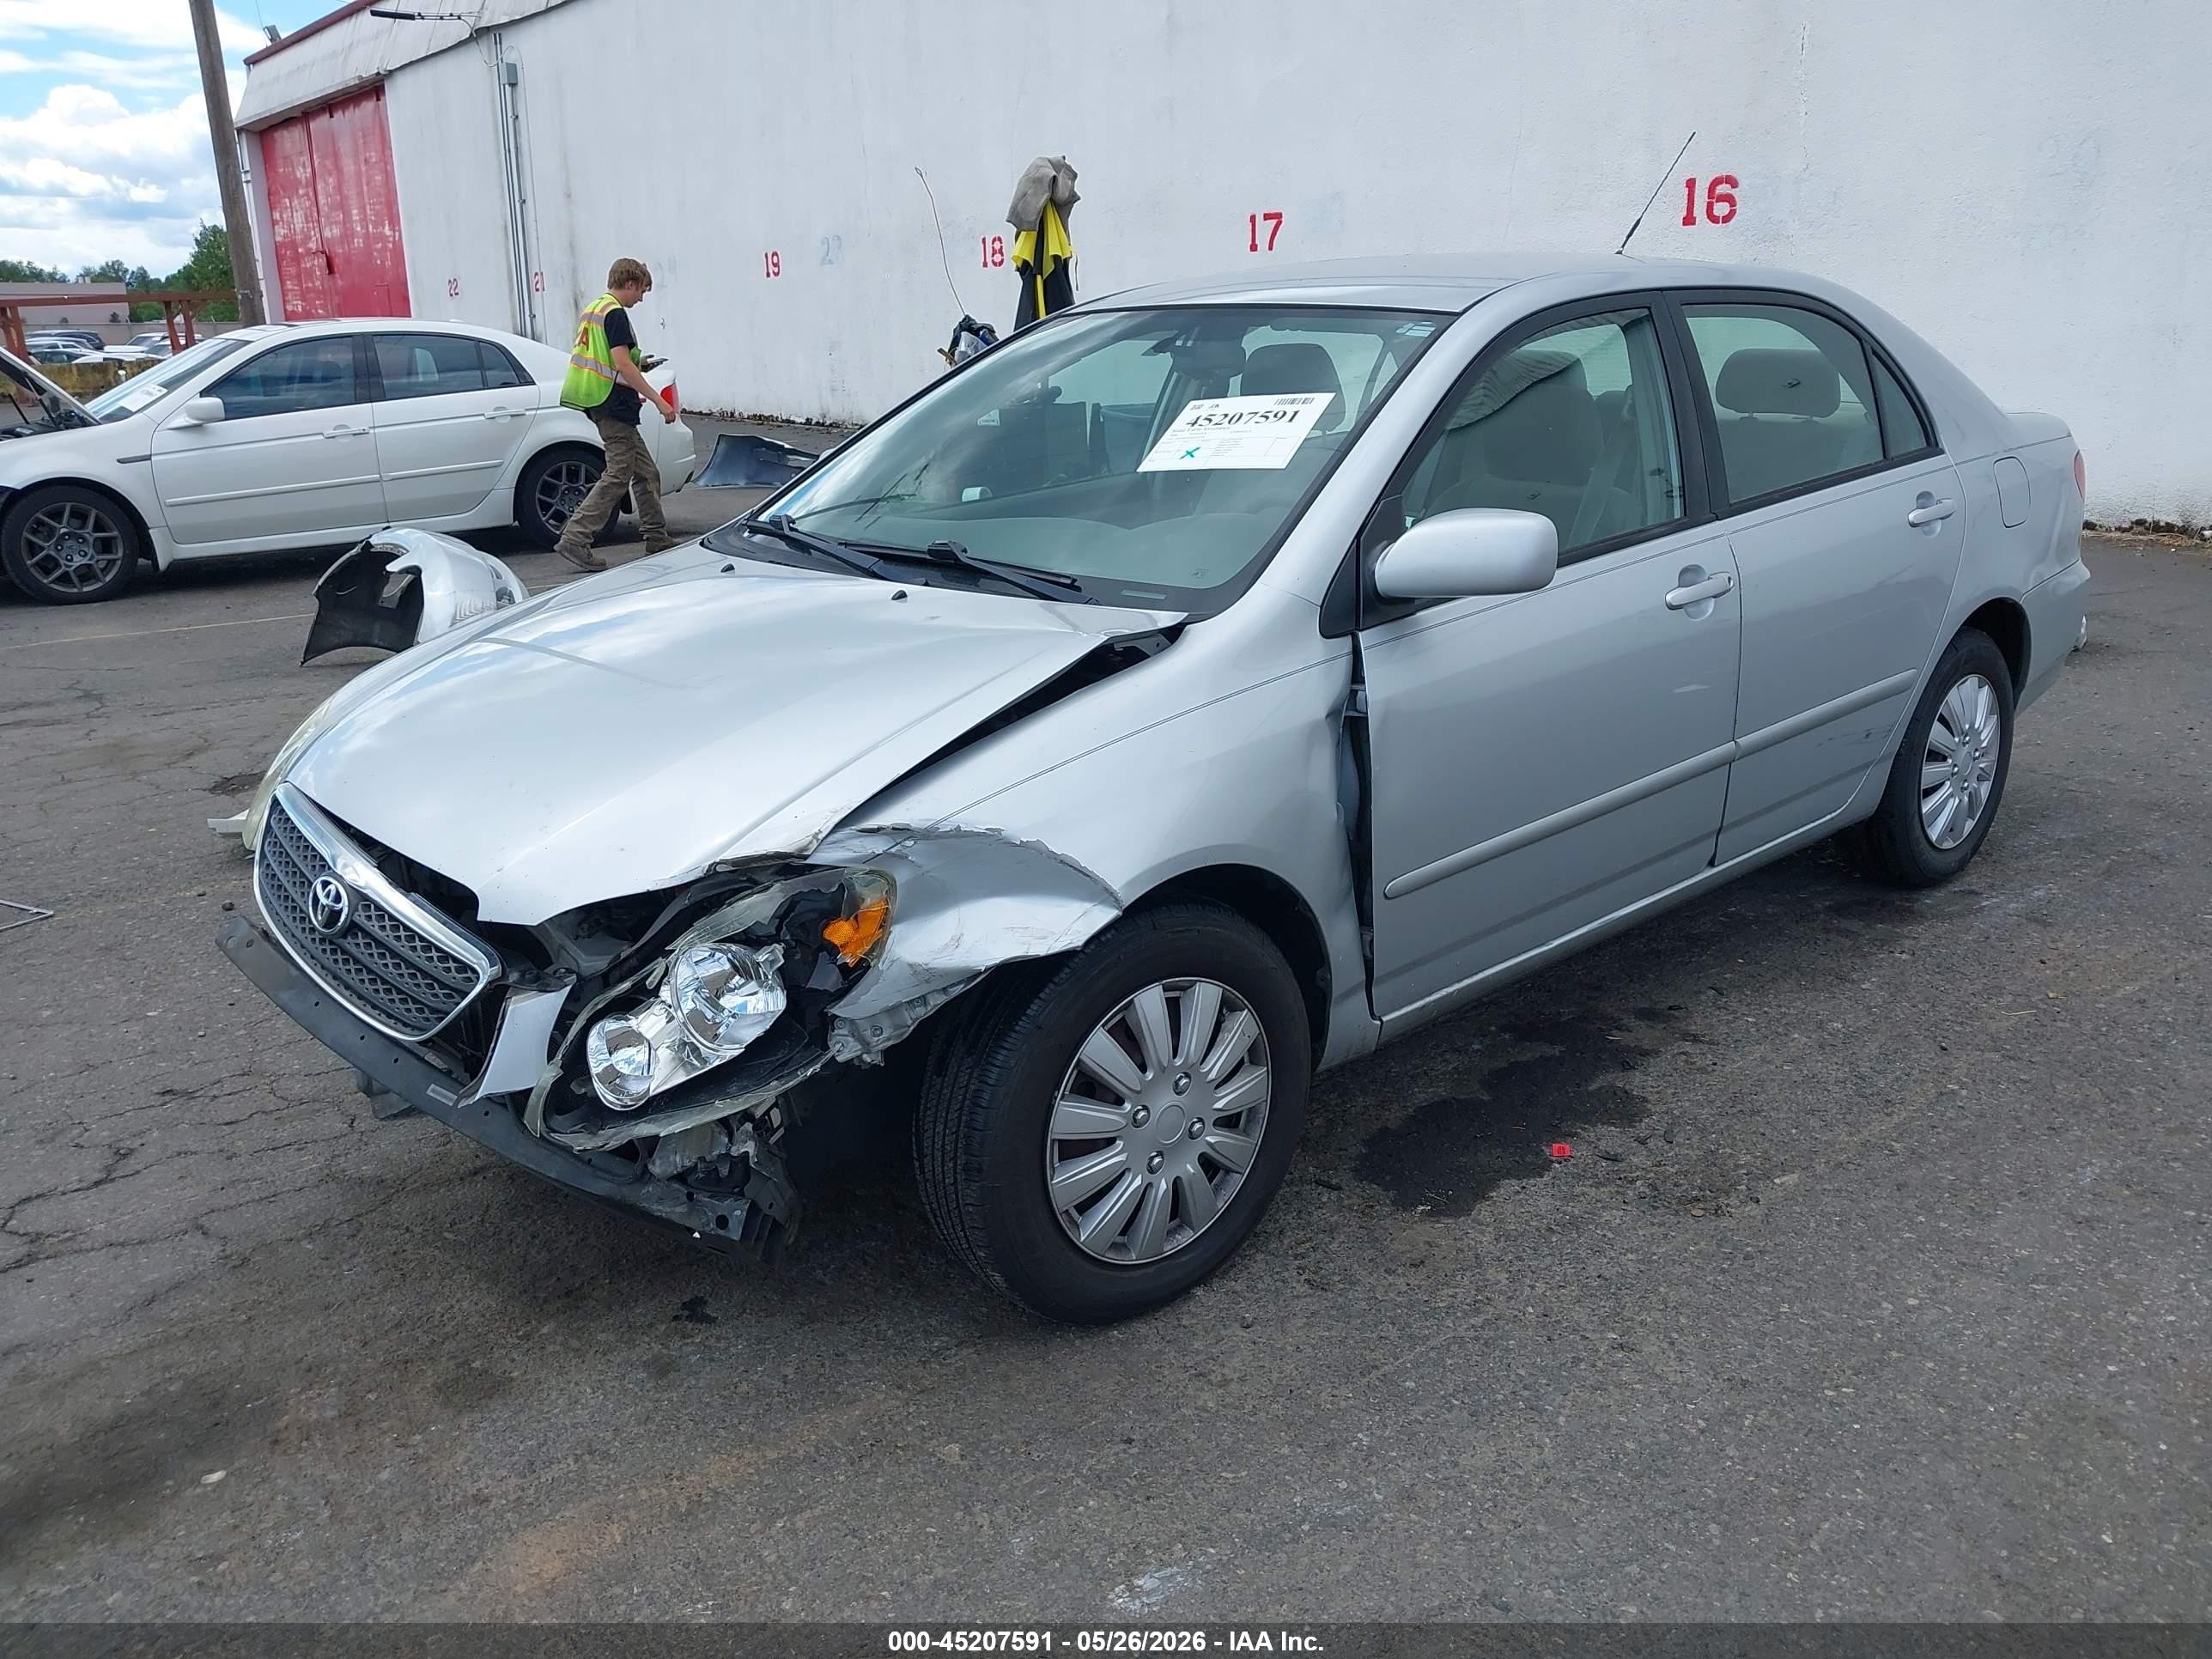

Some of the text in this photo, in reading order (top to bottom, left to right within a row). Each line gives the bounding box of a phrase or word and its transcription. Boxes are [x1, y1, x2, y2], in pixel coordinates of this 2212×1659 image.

[1681, 174, 1740, 227] 16
[1249, 211, 1284, 252] 17
[764, 251, 781, 278] 19
[981, 234, 1006, 269] 18
[447, 277, 459, 297] 22
[533, 270, 545, 293] 21
[1185, 409, 1301, 428] 45207591
